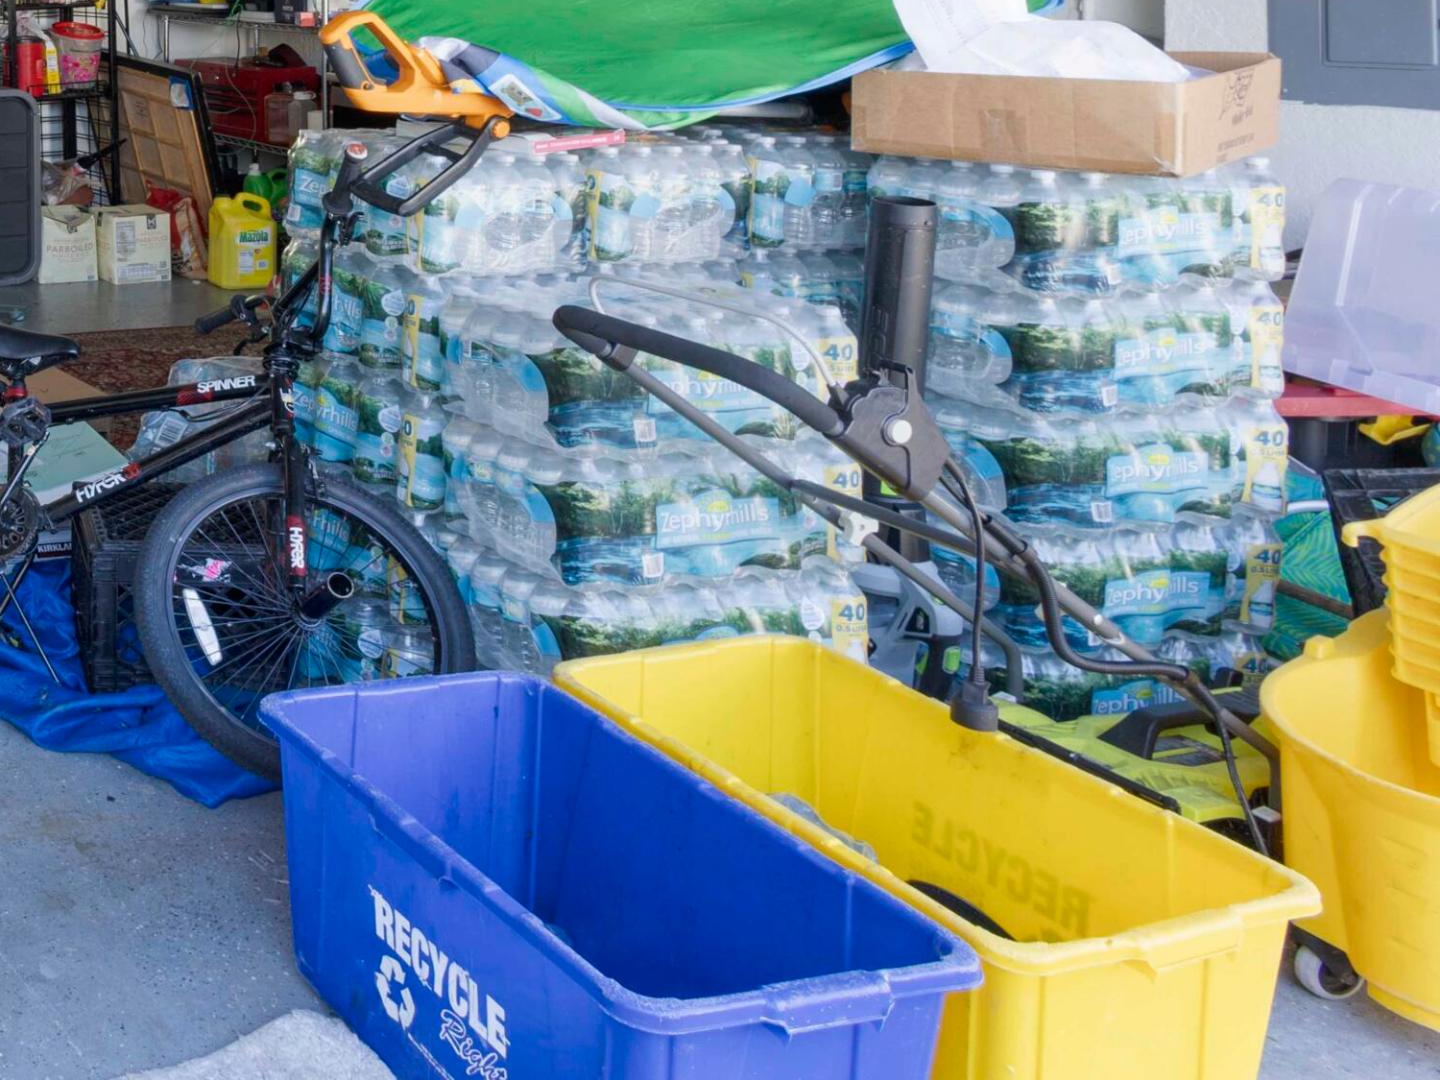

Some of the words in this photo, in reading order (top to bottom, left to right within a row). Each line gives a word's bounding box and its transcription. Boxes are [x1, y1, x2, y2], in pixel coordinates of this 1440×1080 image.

[1259, 192, 1284, 208] 40
[239, 230, 269, 243] Mazola
[1258, 311, 1281, 327] 40
[824, 344, 853, 361] 40
[197, 375, 256, 394] SPINNER
[1255, 431, 1284, 447] 40
[833, 471, 860, 488] 40
[1255, 549, 1281, 565] 40
[838, 603, 865, 621] 40
[368, 884, 510, 1059] RECYCLE
